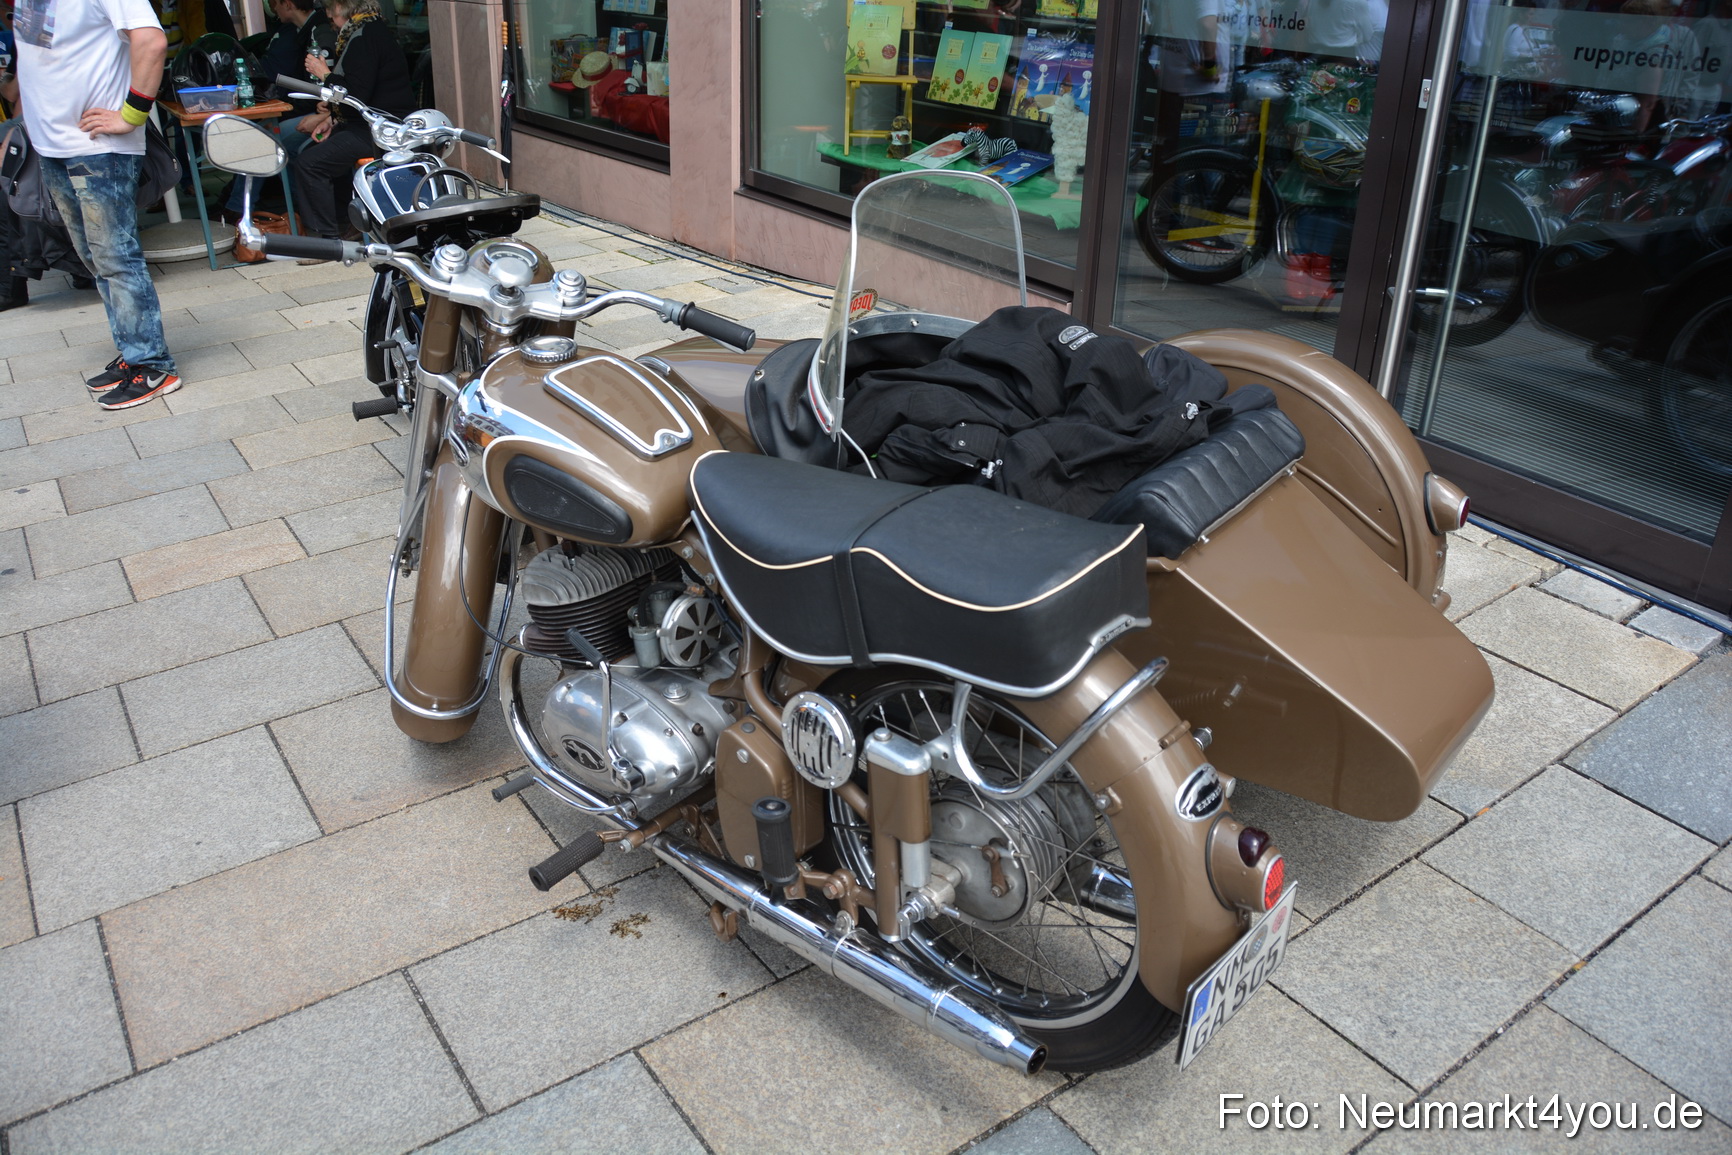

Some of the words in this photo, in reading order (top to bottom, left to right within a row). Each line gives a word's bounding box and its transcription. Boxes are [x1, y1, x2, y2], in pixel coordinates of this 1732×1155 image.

[1216, 9, 1305, 31] rupprecht.de
[1573, 44, 1721, 73] rupprecht.de
[1192, 998, 1225, 1054] GA
[1232, 935, 1282, 1012] 505
[1211, 943, 1248, 1008] NM
